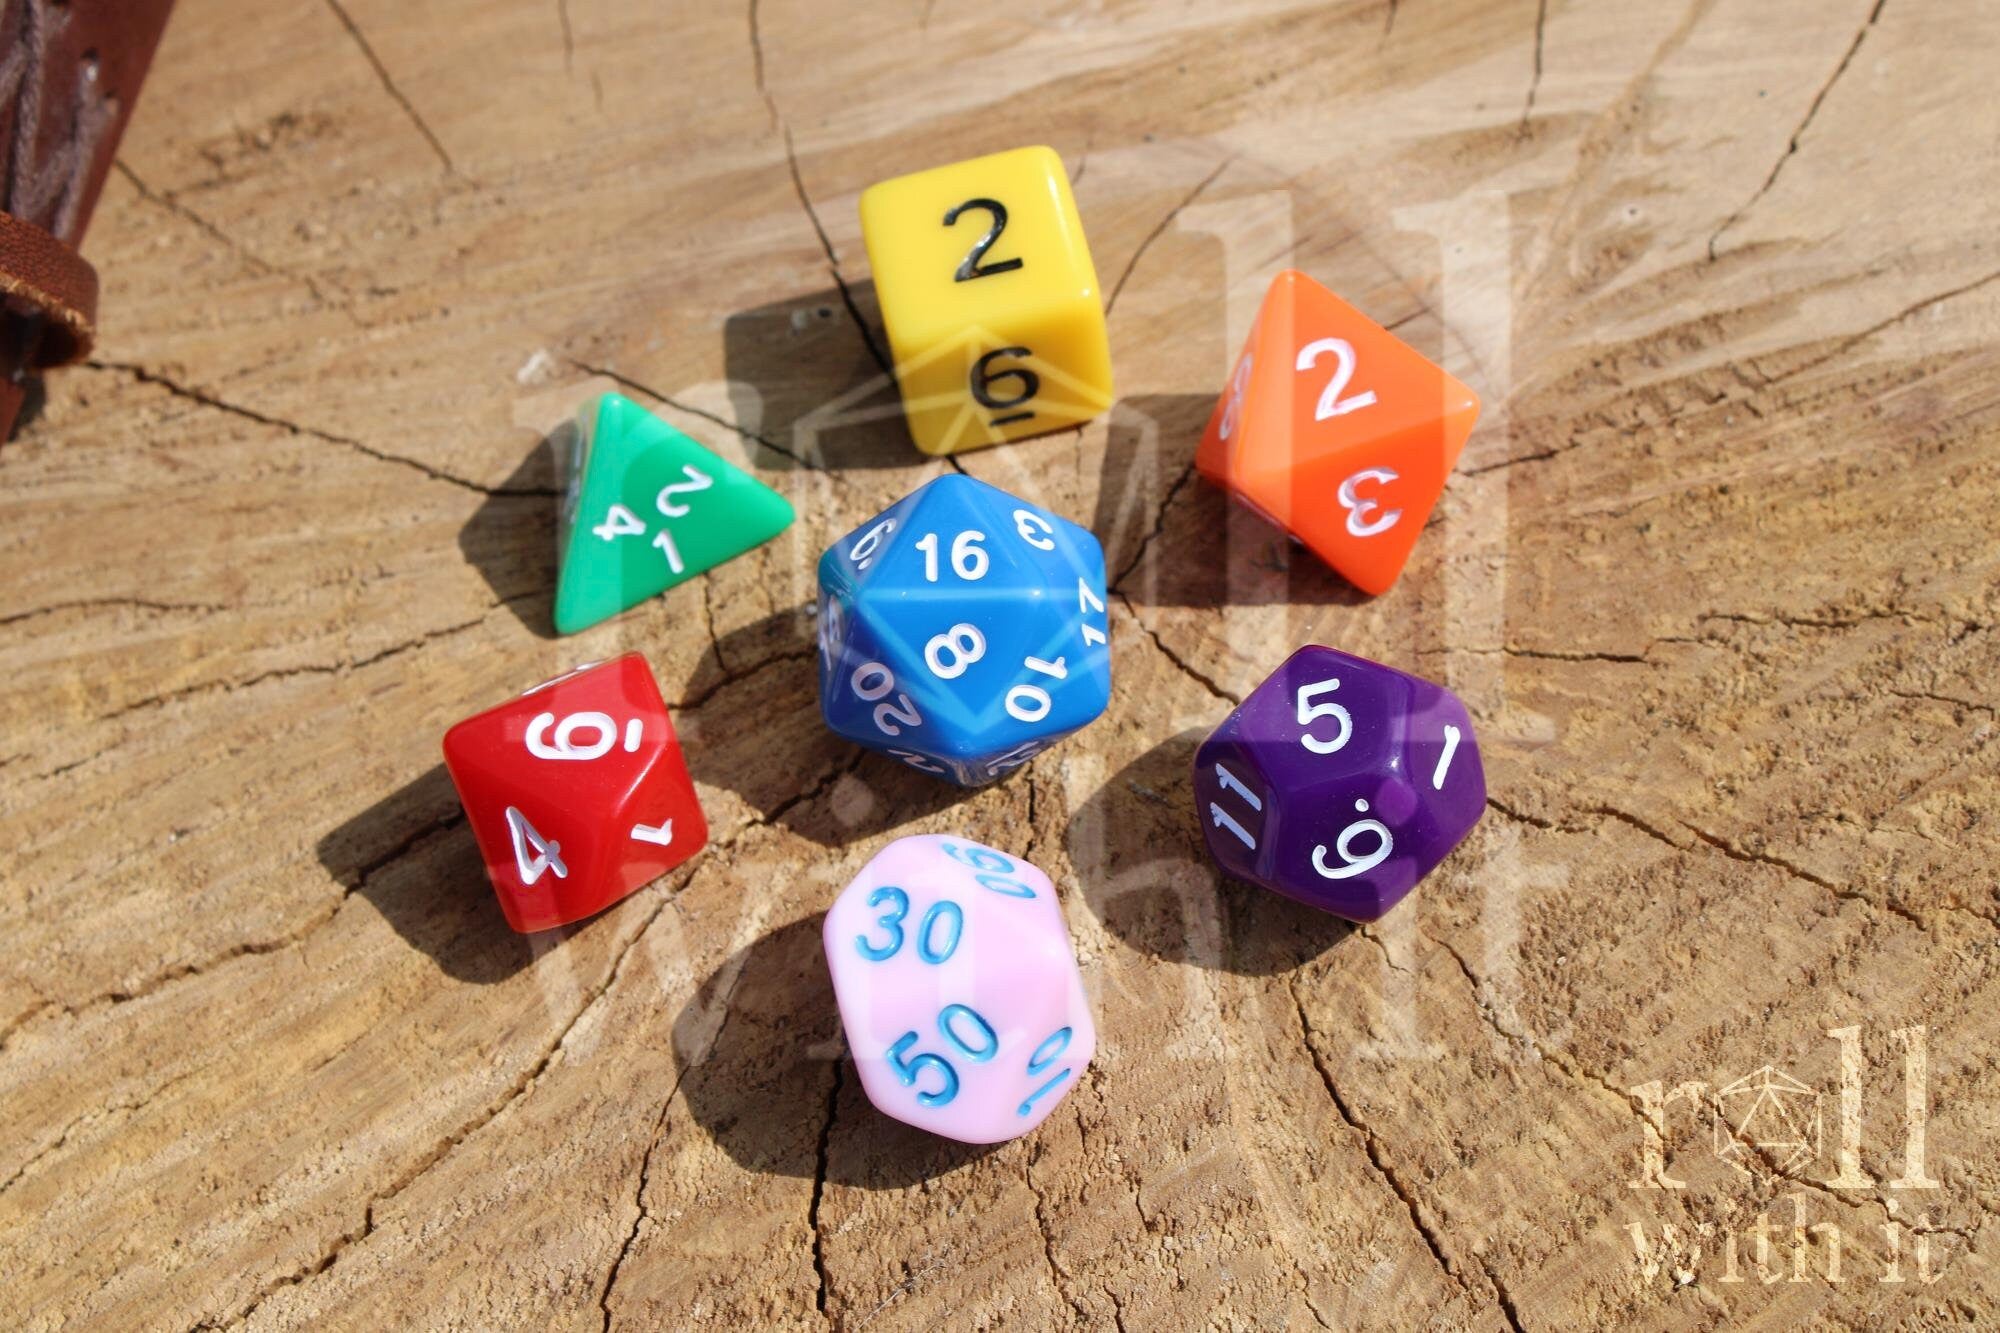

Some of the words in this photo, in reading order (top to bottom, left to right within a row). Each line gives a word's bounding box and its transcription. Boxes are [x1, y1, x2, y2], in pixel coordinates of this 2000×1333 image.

[942, 198, 1024, 283] 2
[1296, 337, 1377, 421] 2
[592, 504, 647, 542] 4
[656, 464, 713, 518] 2
[1337, 466, 1402, 538] 3
[652, 529, 684, 574] 1
[915, 530, 989, 582] 16
[1013, 509, 1055, 551] 3
[1078, 577, 1106, 646] 17
[924, 623, 986, 679] 8
[852, 662, 922, 736] 20
[1005, 656, 1068, 722] 10
[1297, 678, 1353, 754] 5
[1432, 724, 1461, 790] 1
[630, 818, 673, 846] 1
[1209, 762, 1262, 851] 11
[505, 806, 568, 885] 4
[855, 885, 964, 965] 30
[885, 1003, 999, 1108] 50
